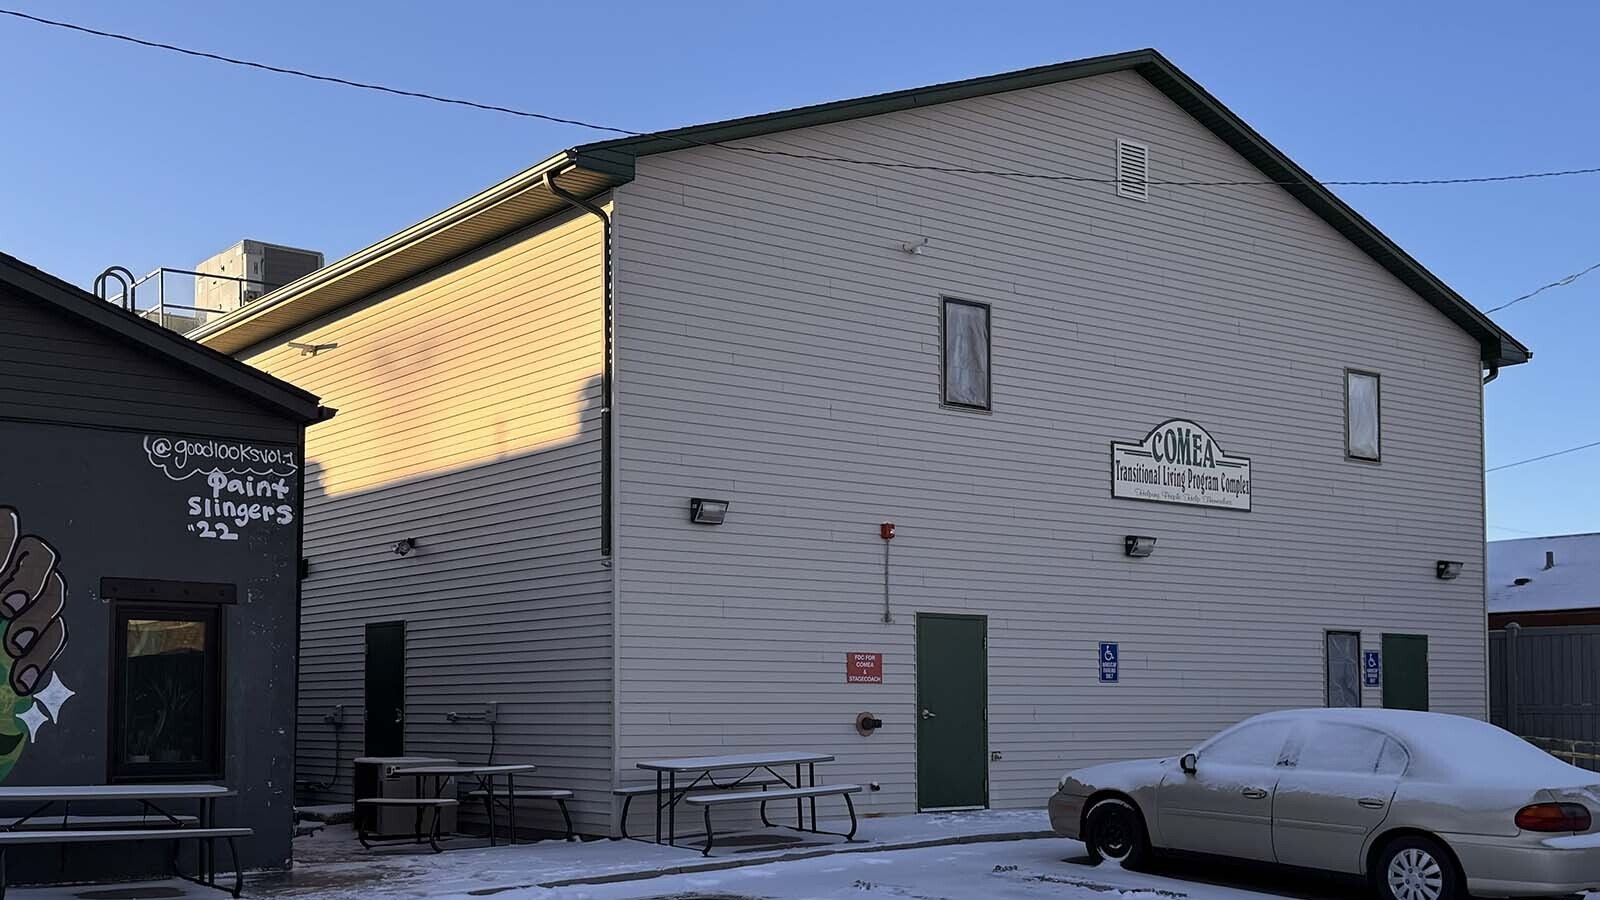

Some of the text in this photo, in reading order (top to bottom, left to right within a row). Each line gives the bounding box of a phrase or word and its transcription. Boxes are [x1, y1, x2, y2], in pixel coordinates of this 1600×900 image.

[1152, 427, 1215, 468] COMEA
[1116, 460, 1250, 498] Transitional Living Program Complex
